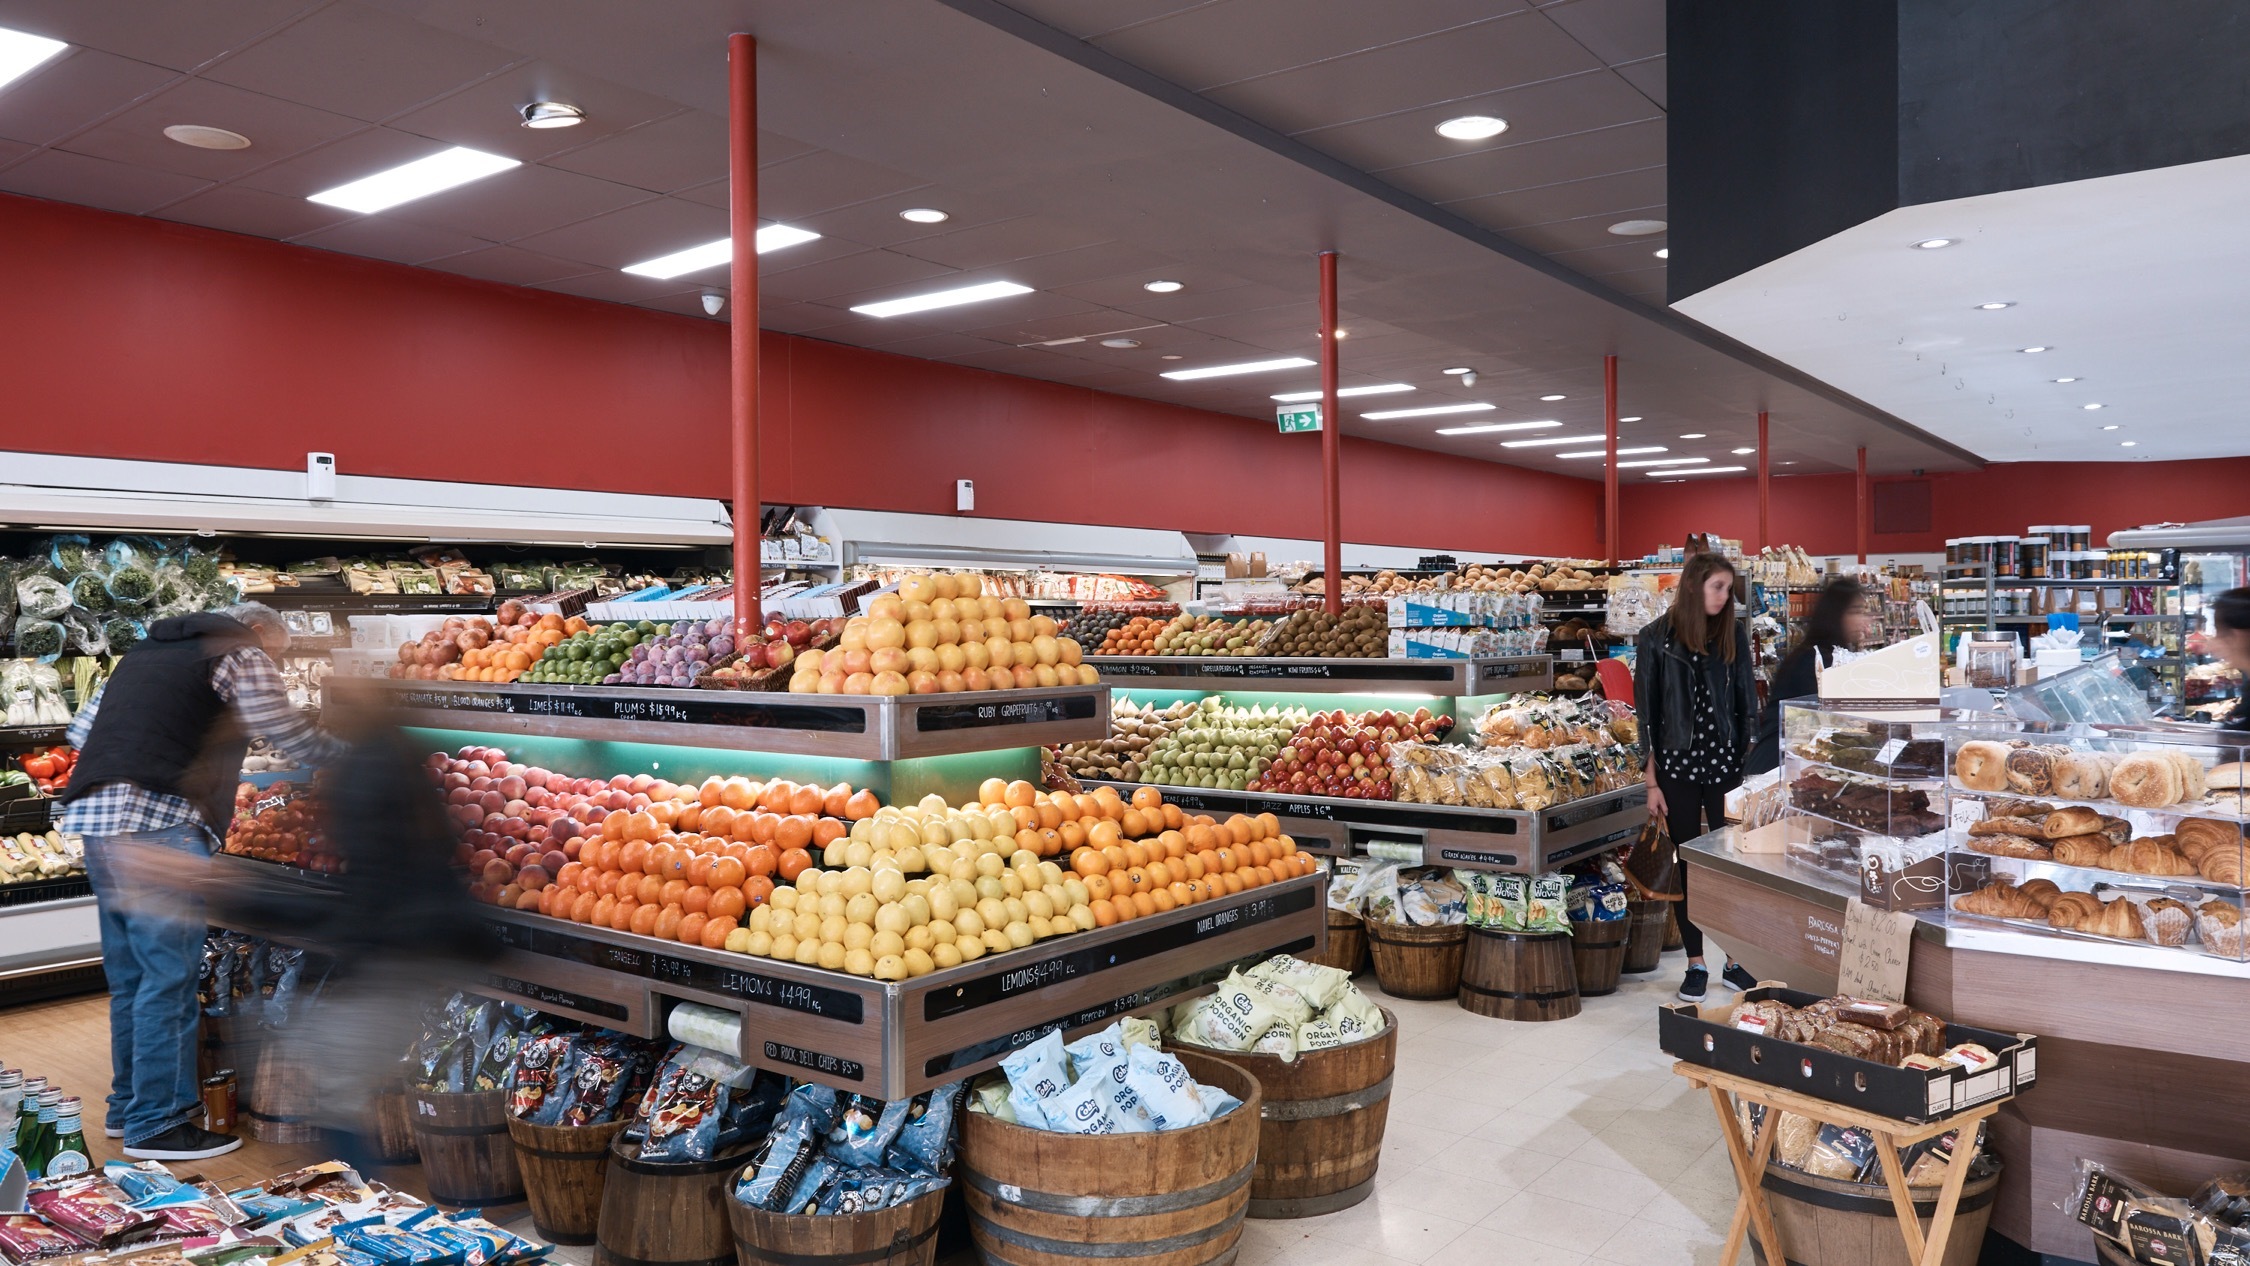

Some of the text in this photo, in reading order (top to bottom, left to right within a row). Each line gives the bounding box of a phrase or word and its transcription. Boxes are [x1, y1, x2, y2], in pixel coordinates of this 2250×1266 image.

[529, 698, 552, 712] LIMES
[614, 701, 646, 715] PLUMS
[977, 705, 997, 719] RUBY
[1261, 800, 1282, 811] JAZZ
[1288, 803, 1311, 815] APPLES
[1534, 887, 1562, 900] Waves
[1535, 879, 1562, 890] Grain
[1196, 919, 1215, 935] NAVEL
[1215, 908, 1239, 928] ORANGES
[722, 972, 773, 996] LEMONS
[1001, 968, 1035, 992] LEMONS
[1208, 1003, 1248, 1042] POPCORN
[1214, 996, 1253, 1033] ORGANIC
[1011, 1029, 1037, 1046] COBS
[764, 1042, 778, 1058] RED
[780, 1045, 797, 1062] ROCK
[799, 1050, 814, 1067] DELI
[818, 1054, 838, 1071] CHIPS
[1075, 1099, 1101, 1122] Cobs
[1931, 1102, 1946, 1113] CLASS
[2079, 1174, 2100, 1222] BAROSSA BARK
[2129, 1223, 2162, 1238] BAROSSA
[2162, 1231, 2184, 1242] BARK
